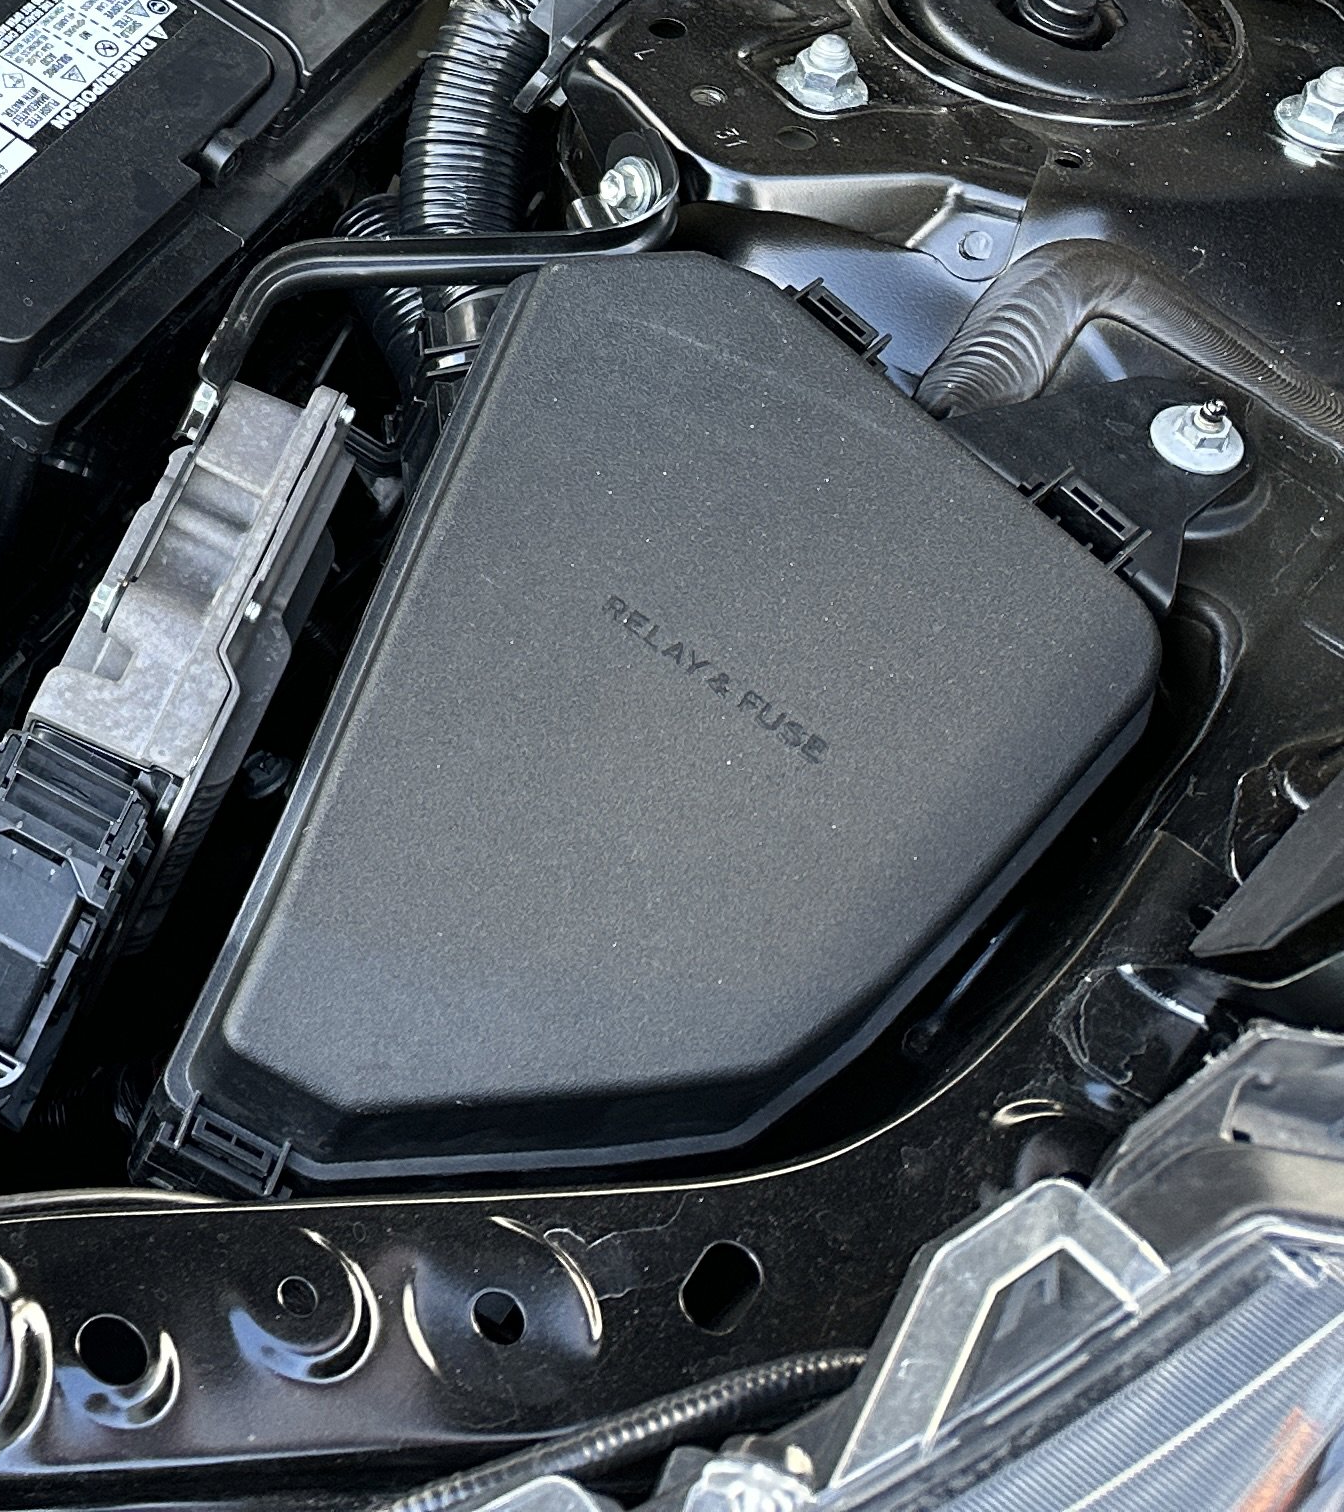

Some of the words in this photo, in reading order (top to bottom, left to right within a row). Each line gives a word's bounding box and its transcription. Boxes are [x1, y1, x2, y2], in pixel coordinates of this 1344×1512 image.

[24, 113, 44, 129] EYES
[52, 39, 155, 128] DANGER/POISON
[601, 593, 711, 676] RELAY
[706, 672, 732, 699] &
[736, 689, 830, 766] FUSE
